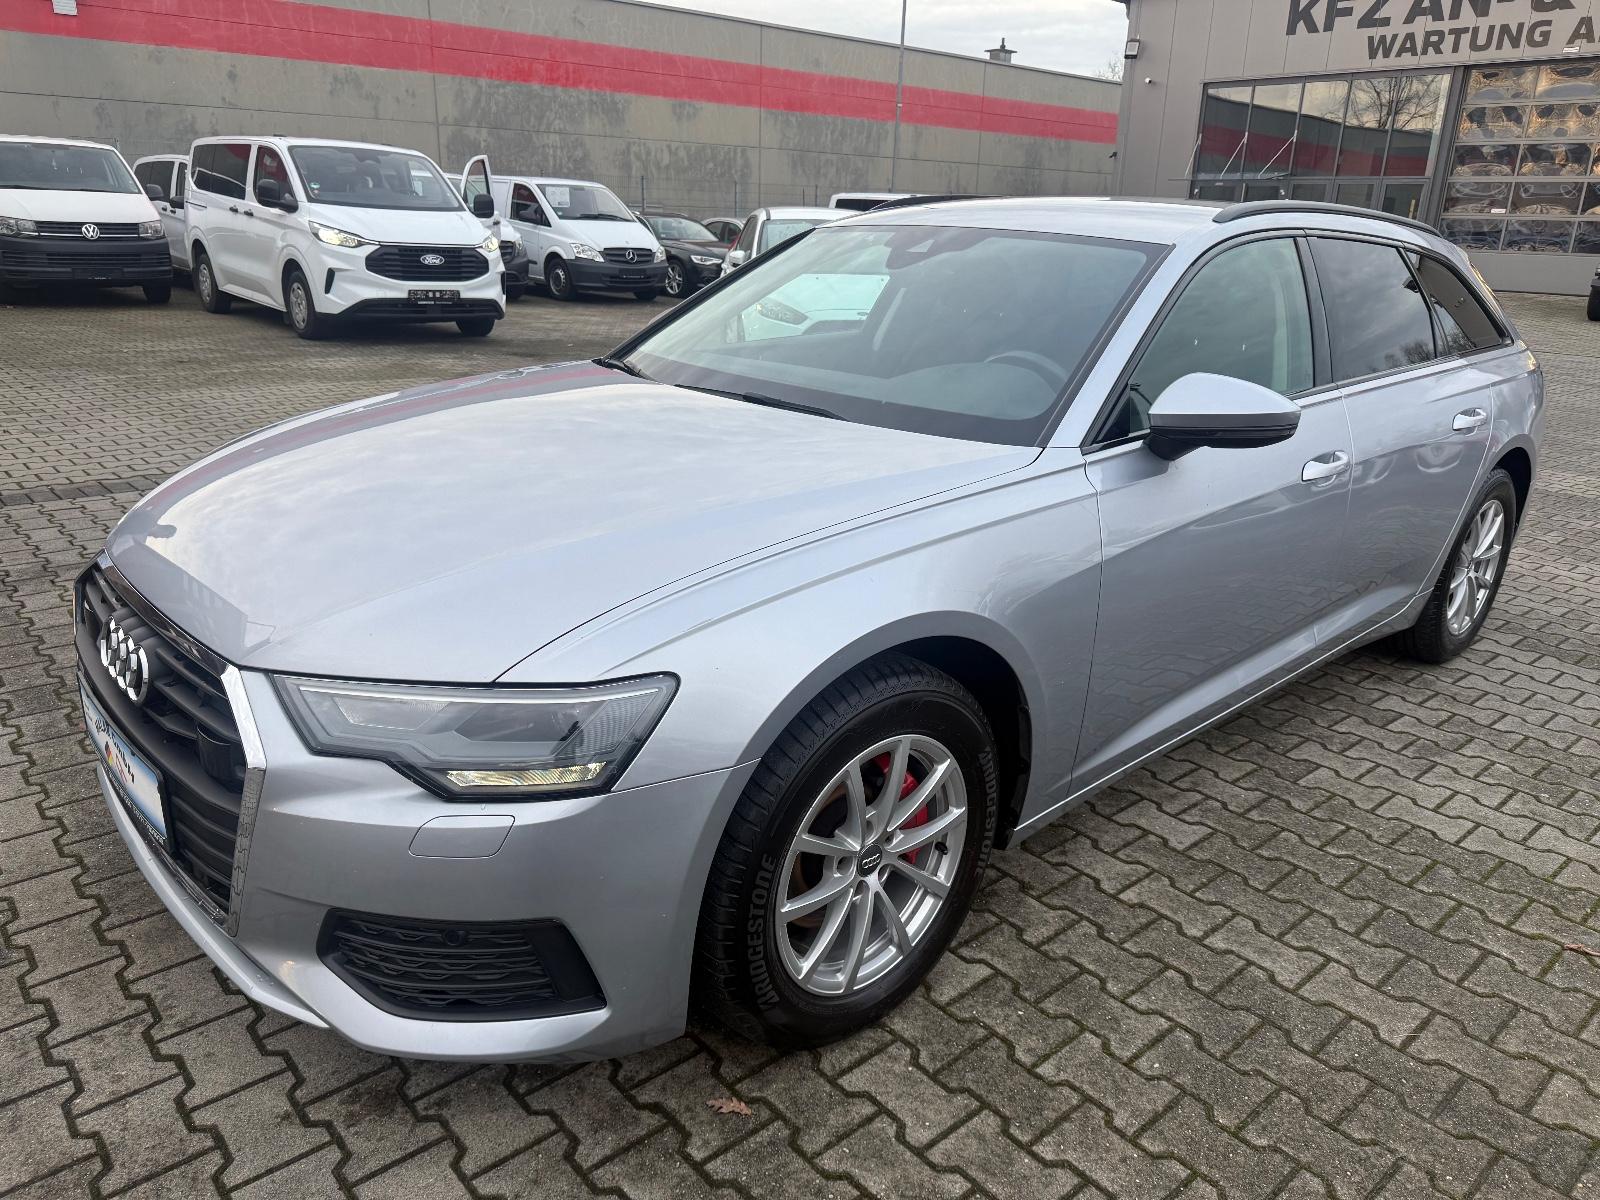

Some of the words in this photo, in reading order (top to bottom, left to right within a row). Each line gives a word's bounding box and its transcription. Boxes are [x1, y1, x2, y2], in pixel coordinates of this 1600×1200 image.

[1286, 0, 1391, 35] KFZ
[1367, 20, 1553, 59] WARTUNG
[747, 853, 779, 1008] BRIDGESTONE
